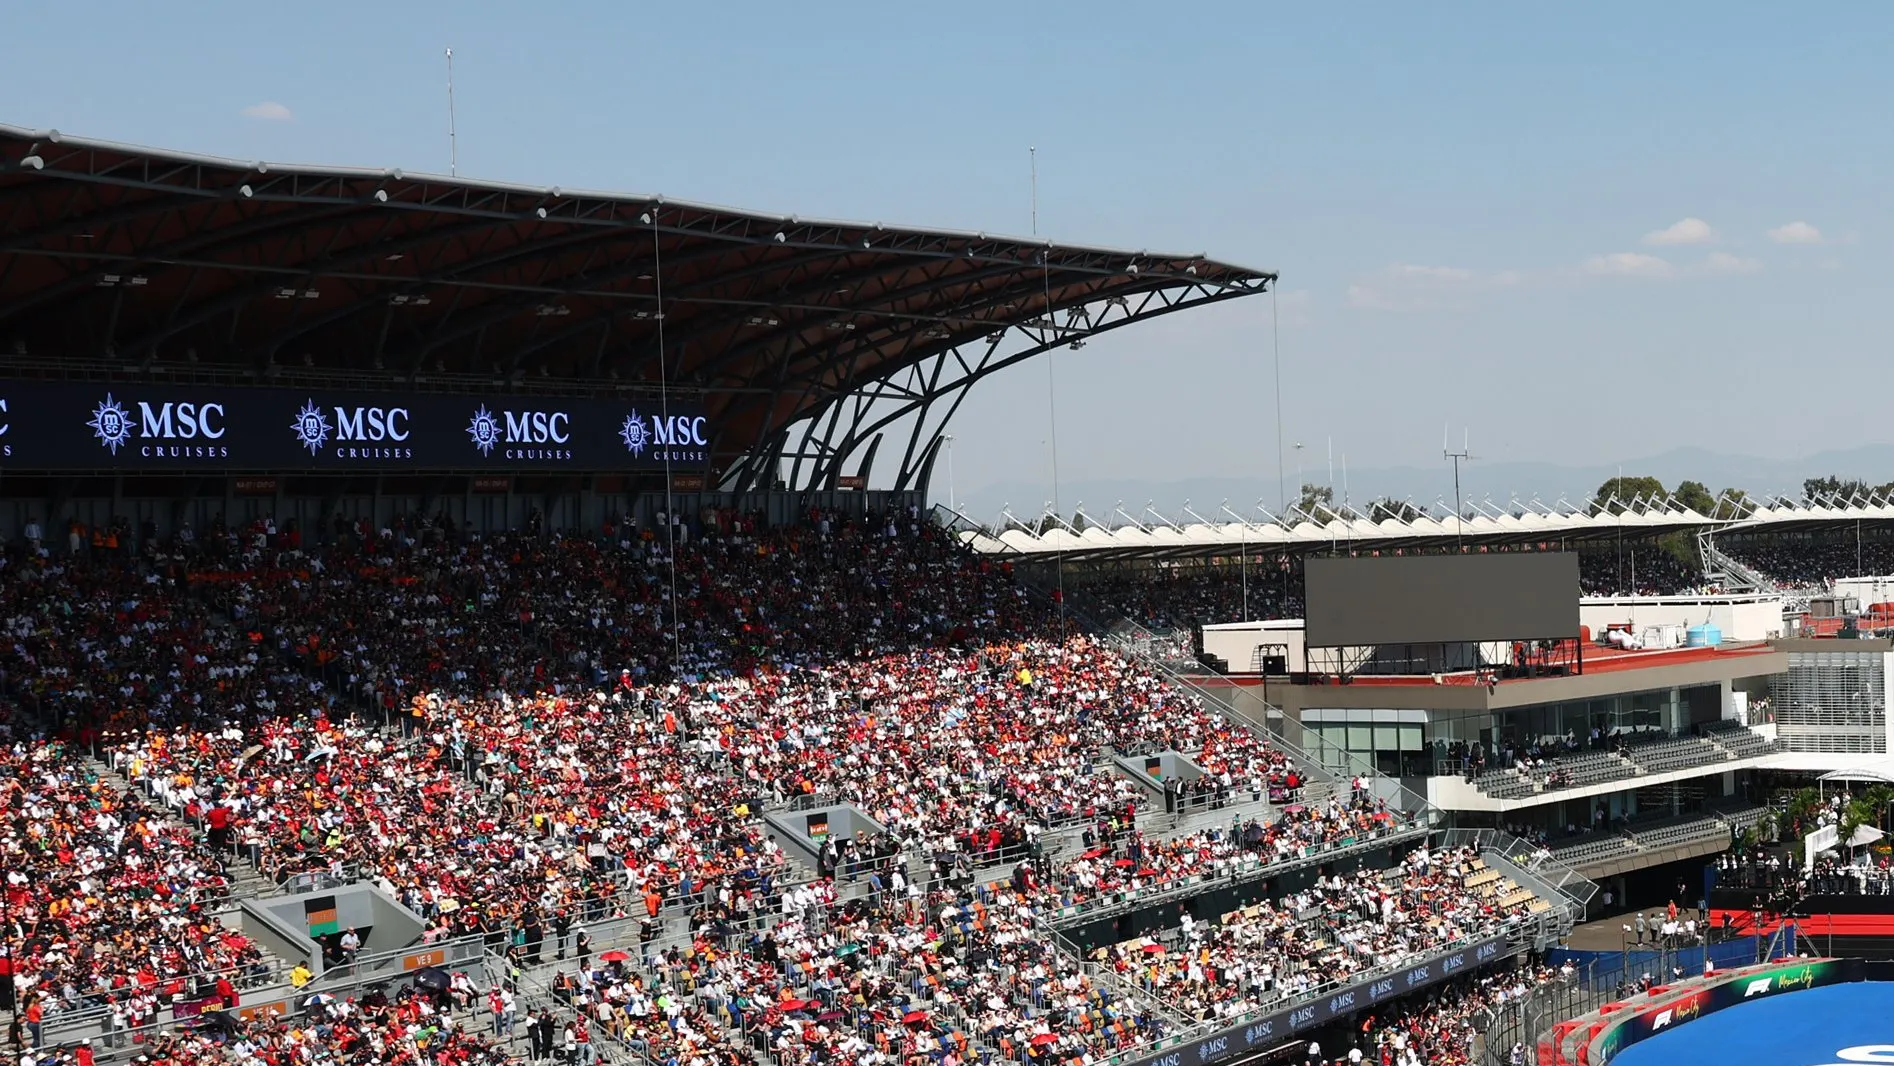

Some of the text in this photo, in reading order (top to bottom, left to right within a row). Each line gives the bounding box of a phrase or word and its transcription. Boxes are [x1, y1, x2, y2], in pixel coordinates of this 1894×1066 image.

[138, 401, 225, 439] MSC
[334, 406, 409, 442] MSC
[504, 411, 569, 444] MSC
[652, 415, 707, 446] MSC
[141, 446, 228, 457] CRUISES
[337, 447, 411, 458] CRUISES
[506, 449, 571, 460] CRUISES
[1483, 942, 1497, 956] MSC
[1449, 954, 1464, 969] MSC
[1414, 966, 1430, 981] MSC
[1779, 965, 1815, 989] Mexico City
[1377, 979, 1393, 995] MSC
[1338, 992, 1355, 1008] MSC
[1298, 1006, 1315, 1022] MSC
[1254, 1021, 1273, 1038] MSC
[1208, 1036, 1228, 1054] MSC
